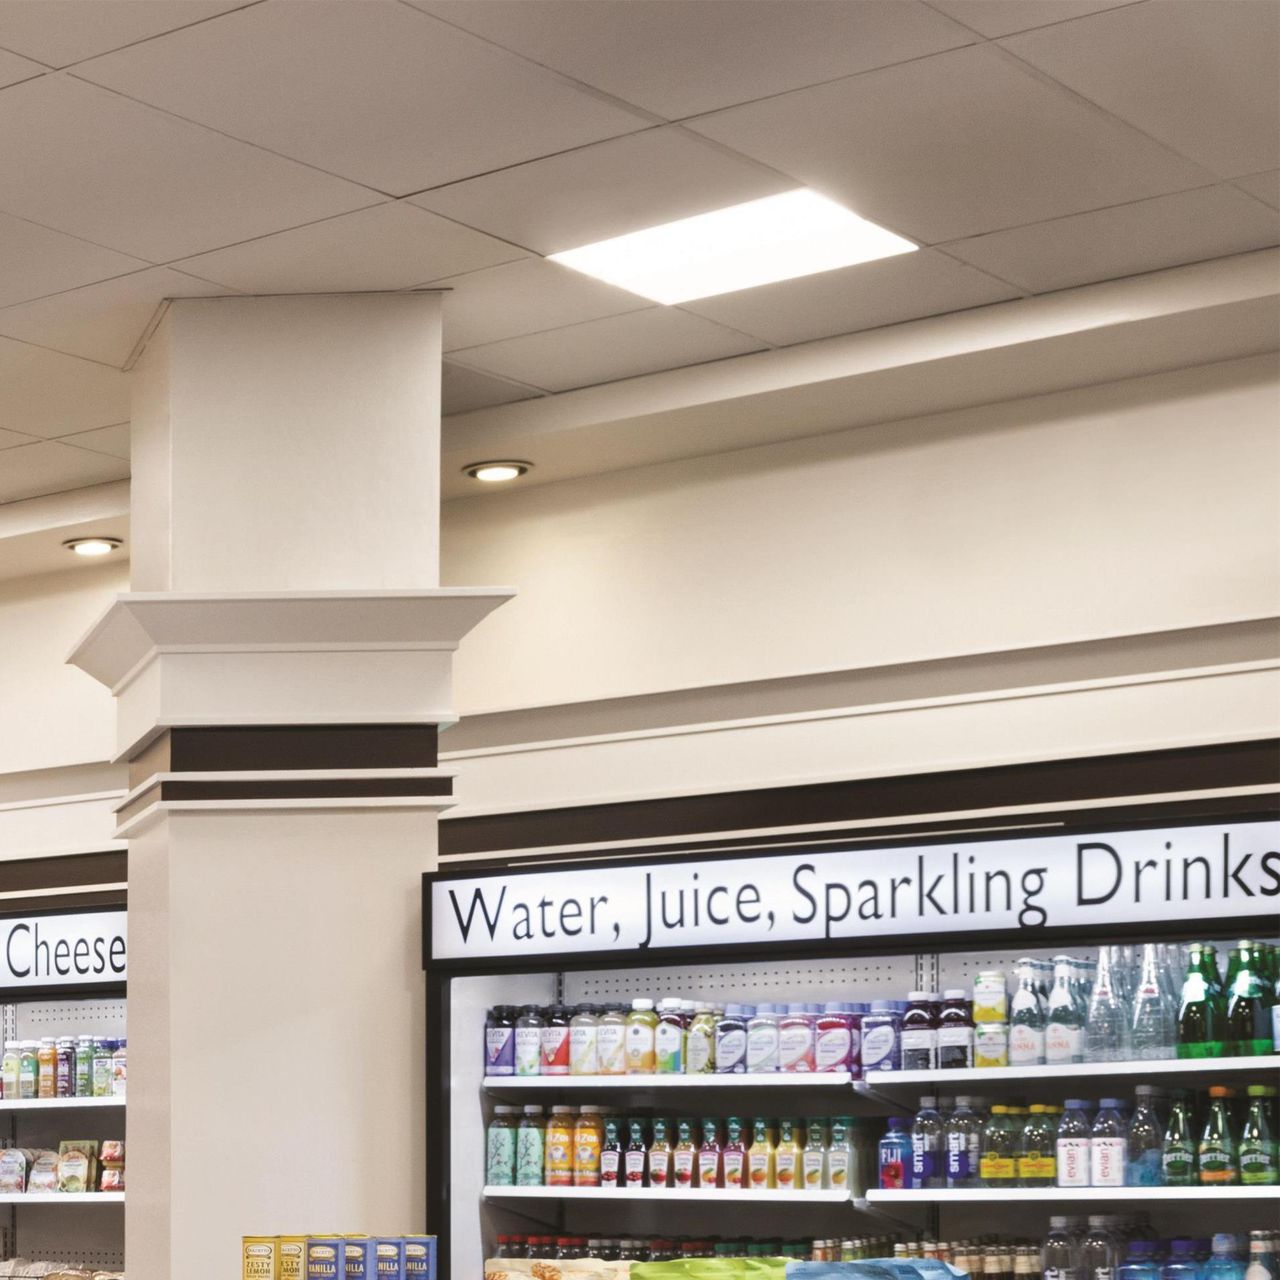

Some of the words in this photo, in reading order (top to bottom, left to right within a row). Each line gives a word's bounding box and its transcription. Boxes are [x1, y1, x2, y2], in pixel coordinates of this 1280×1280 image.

[448, 884, 621, 946] Water,
[639, 872, 776, 949] Juice,
[792, 852, 1049, 940] Sparkling
[1075, 834, 1280, 911] Drinks
[6, 922, 126, 977] Cheese
[949, 1132, 959, 1174] smart
[1100, 1148, 1110, 1179] evian
[308, 1264, 336, 1273] VANILLA
